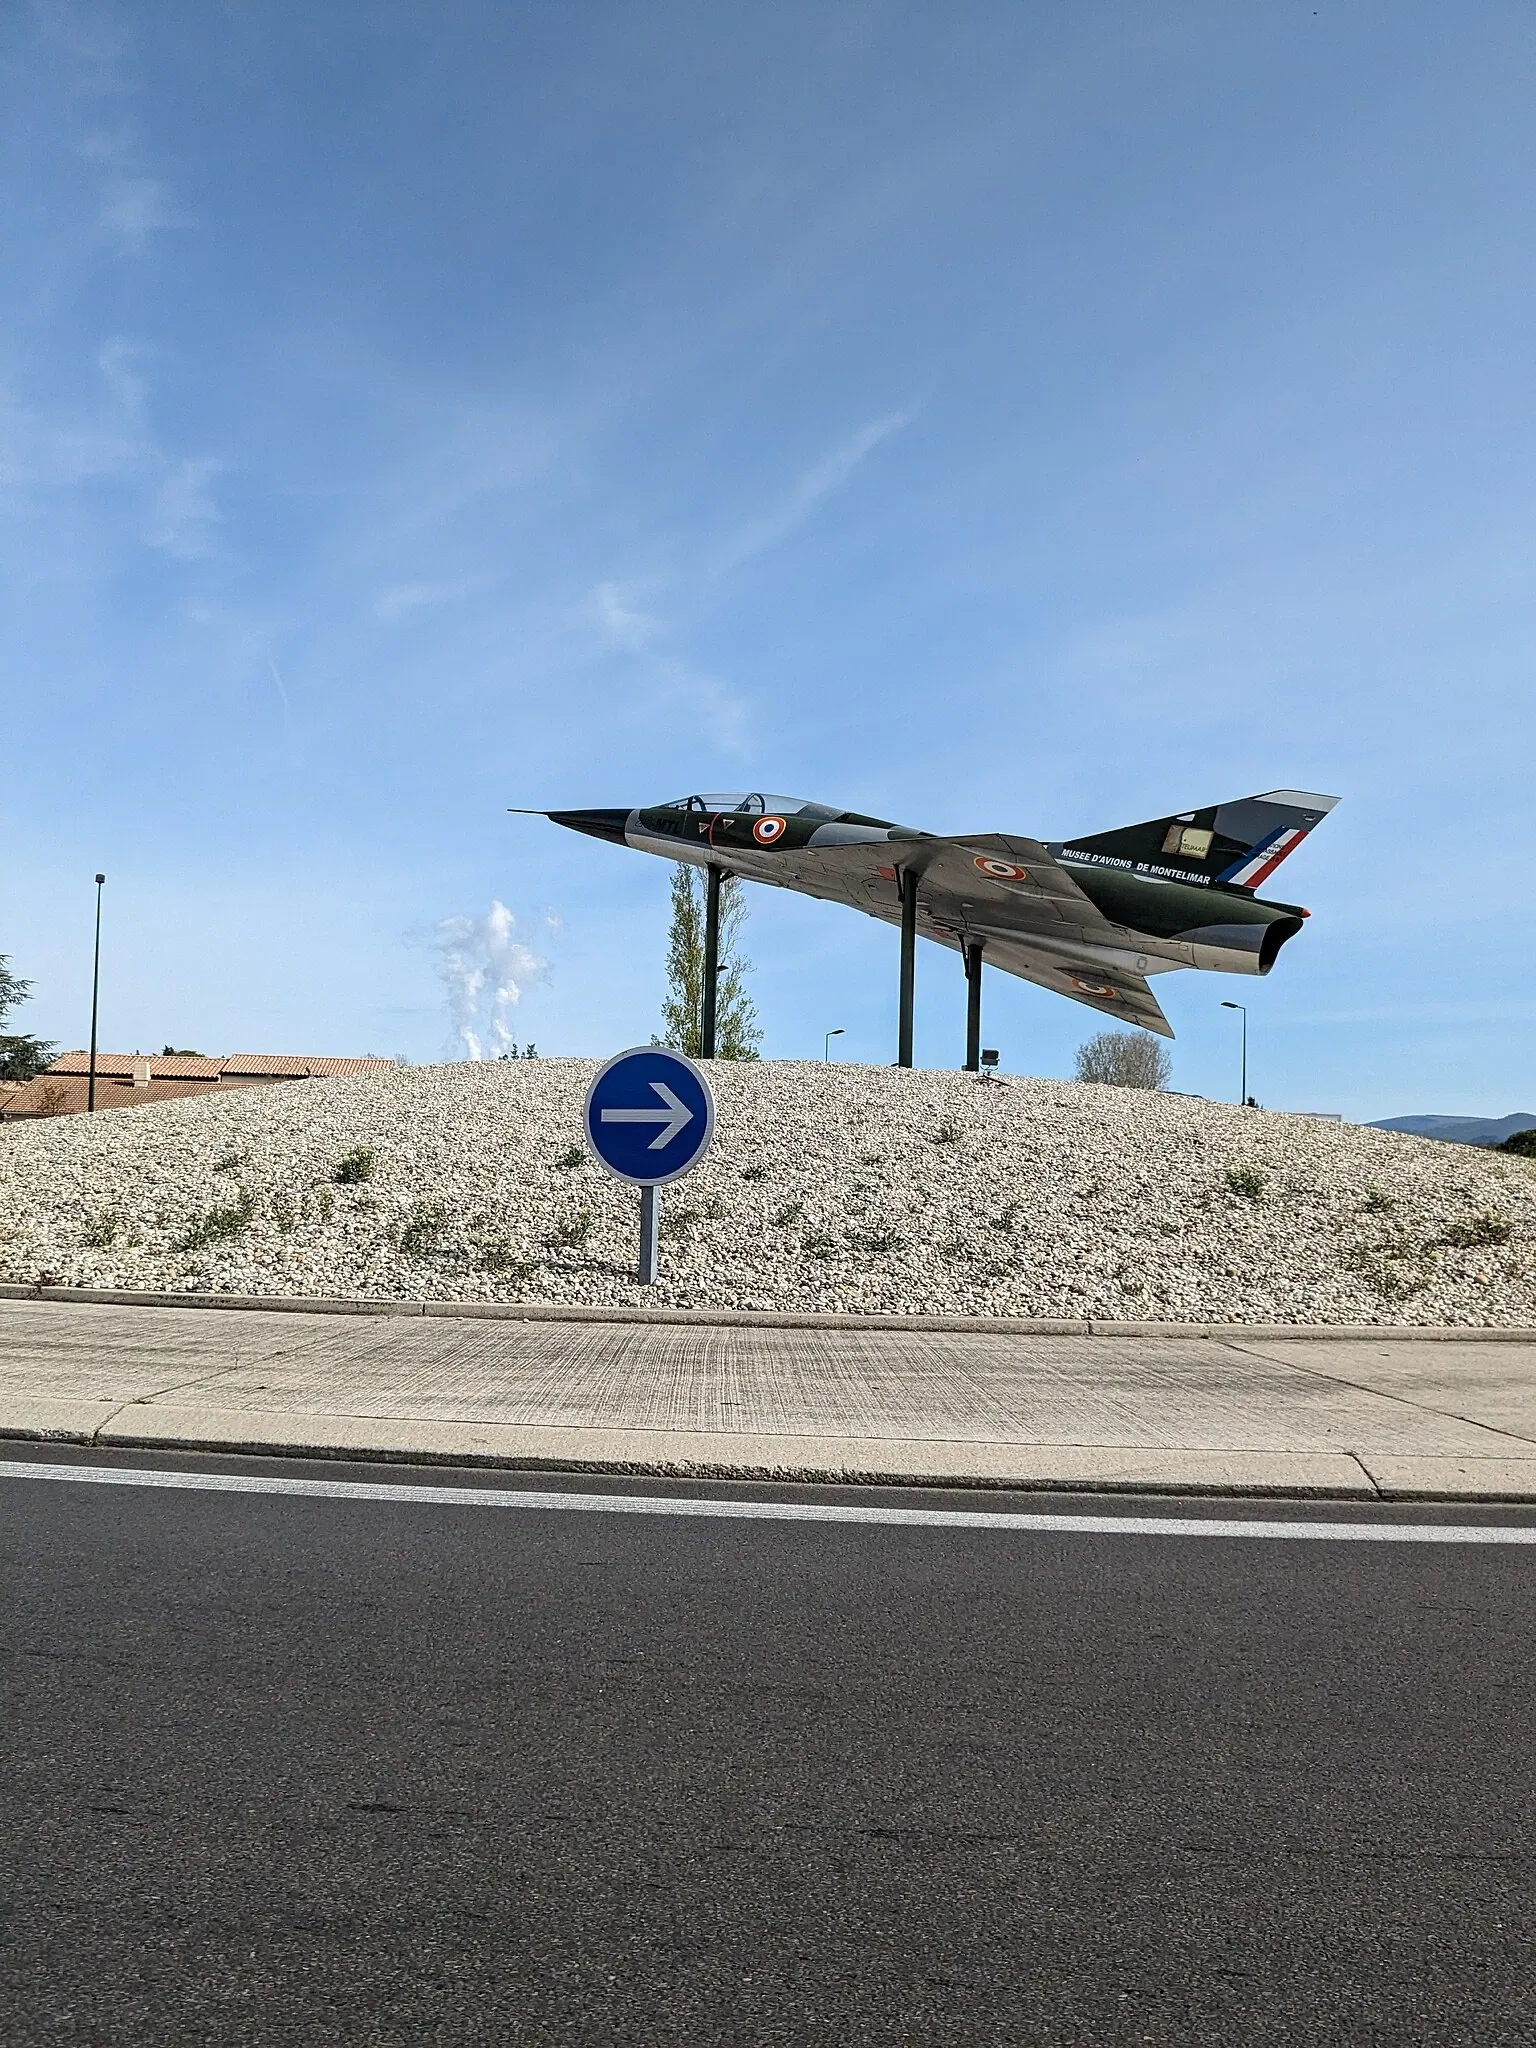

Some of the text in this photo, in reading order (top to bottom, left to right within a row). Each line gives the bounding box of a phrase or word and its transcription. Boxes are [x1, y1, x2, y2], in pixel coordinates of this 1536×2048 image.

[1061, 848, 1211, 885] MUSEE D'AVIONS DE MONTELIMAR
